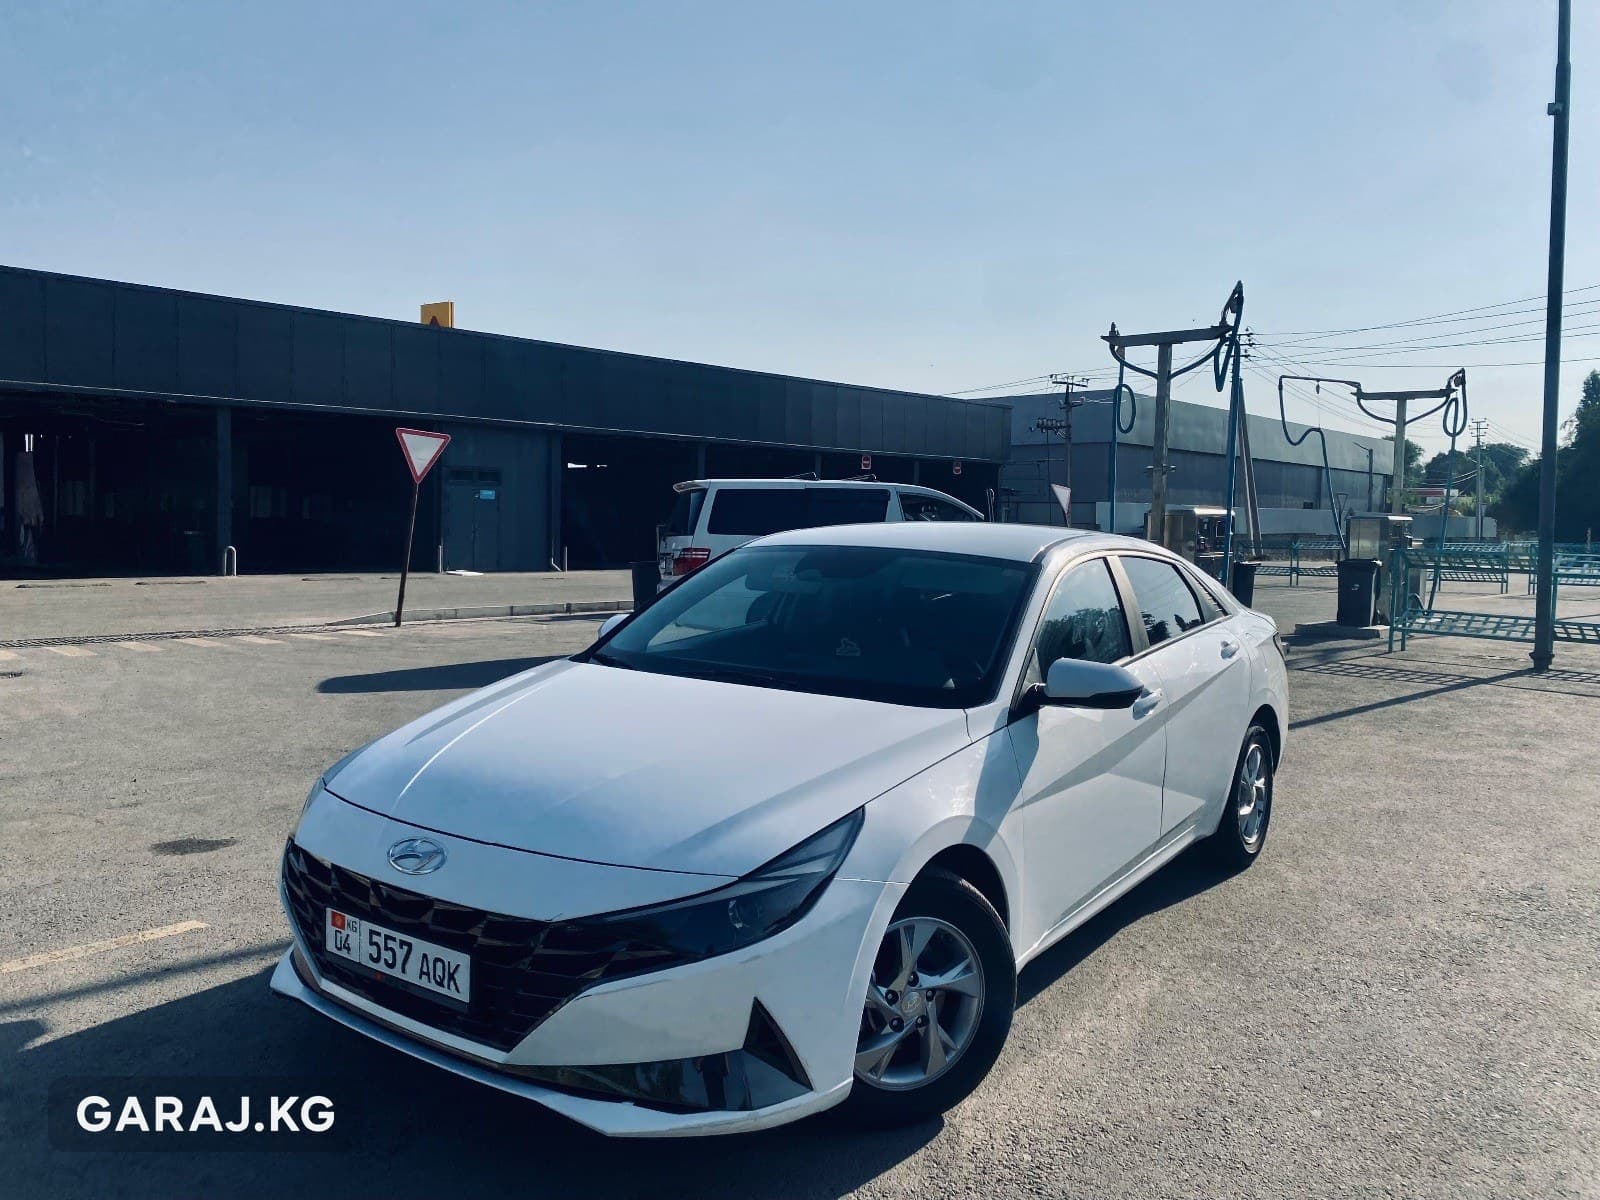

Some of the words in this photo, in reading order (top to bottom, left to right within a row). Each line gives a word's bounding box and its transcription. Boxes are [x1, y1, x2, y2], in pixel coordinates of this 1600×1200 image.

[347, 919, 357, 933] KG
[334, 930, 351, 954] 04
[369, 929, 413, 974] 557
[419, 953, 461, 994] AQK
